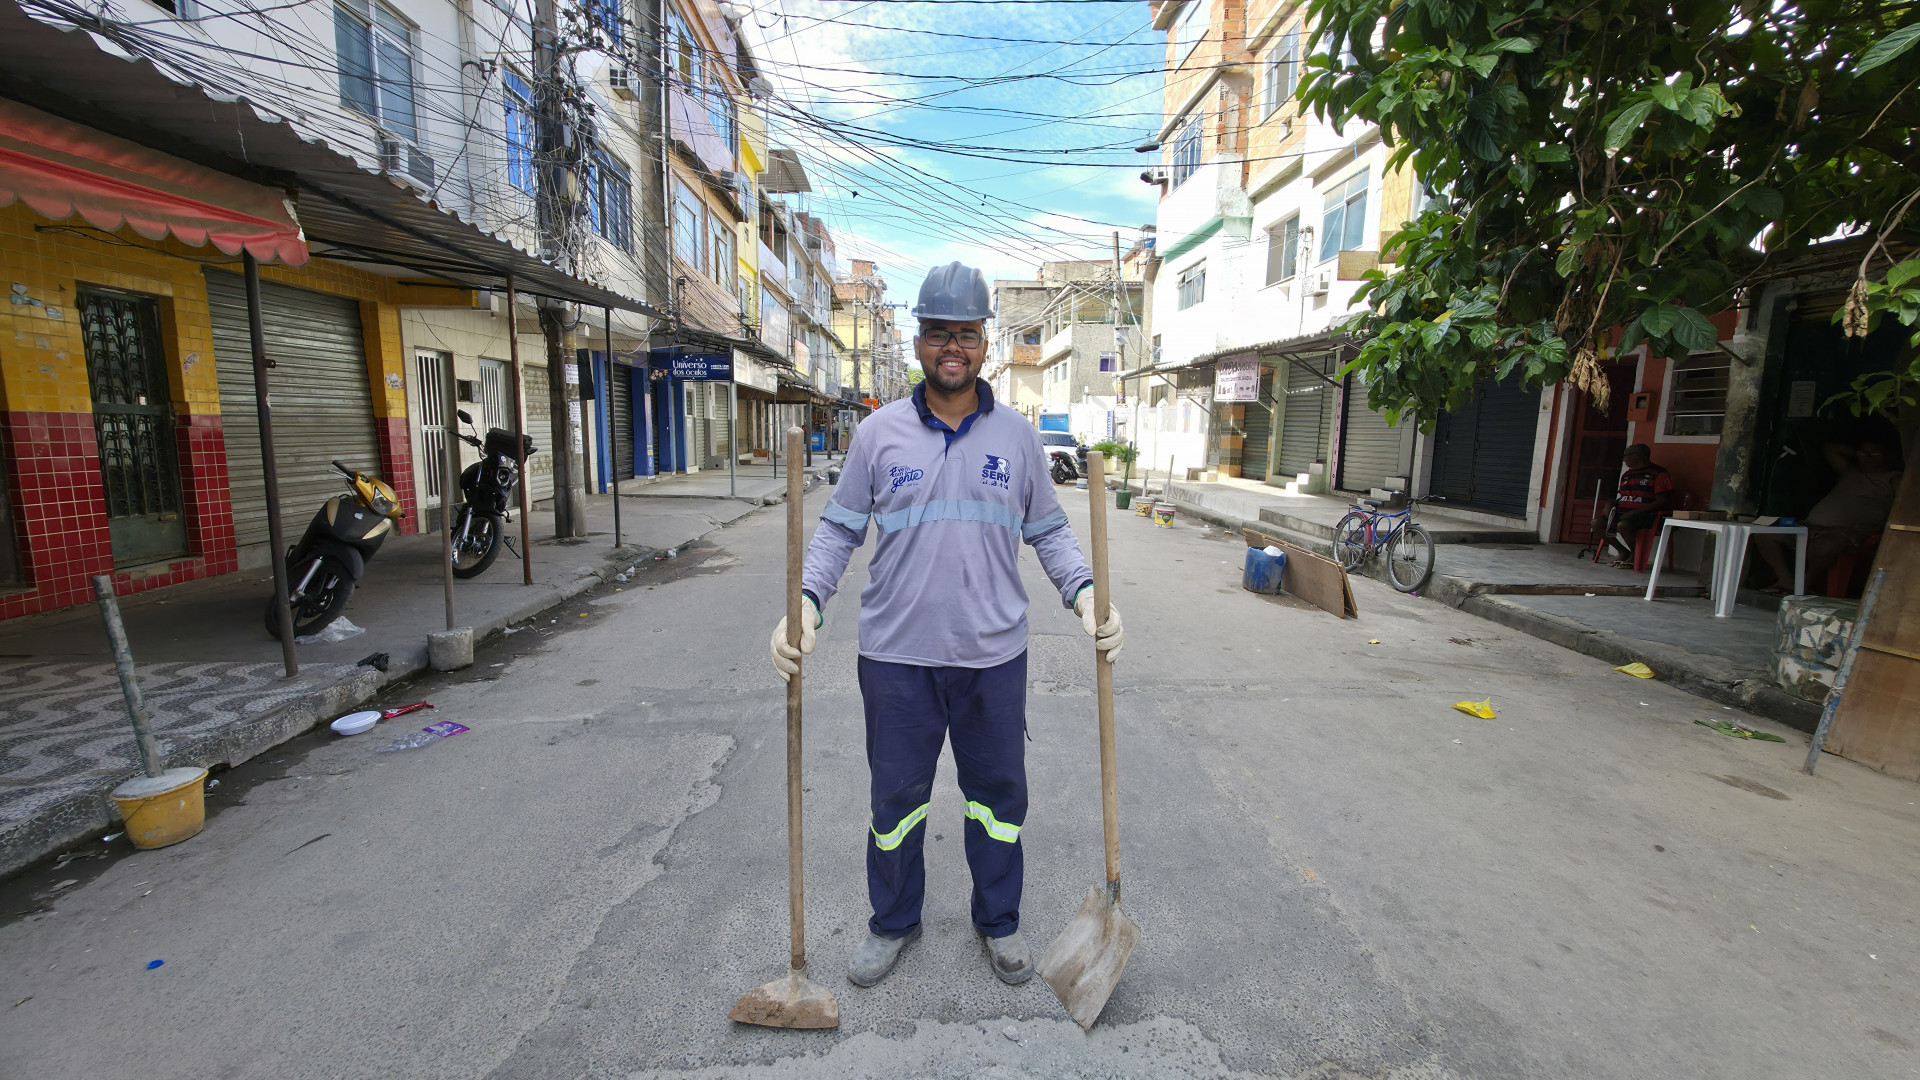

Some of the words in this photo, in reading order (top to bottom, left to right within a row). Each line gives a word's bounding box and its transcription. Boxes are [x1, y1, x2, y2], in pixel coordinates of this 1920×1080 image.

[672, 359, 707, 369] Universo
[672, 368, 685, 376] dos
[890, 469, 924, 494] gente
[981, 469, 1010, 484] SERV
